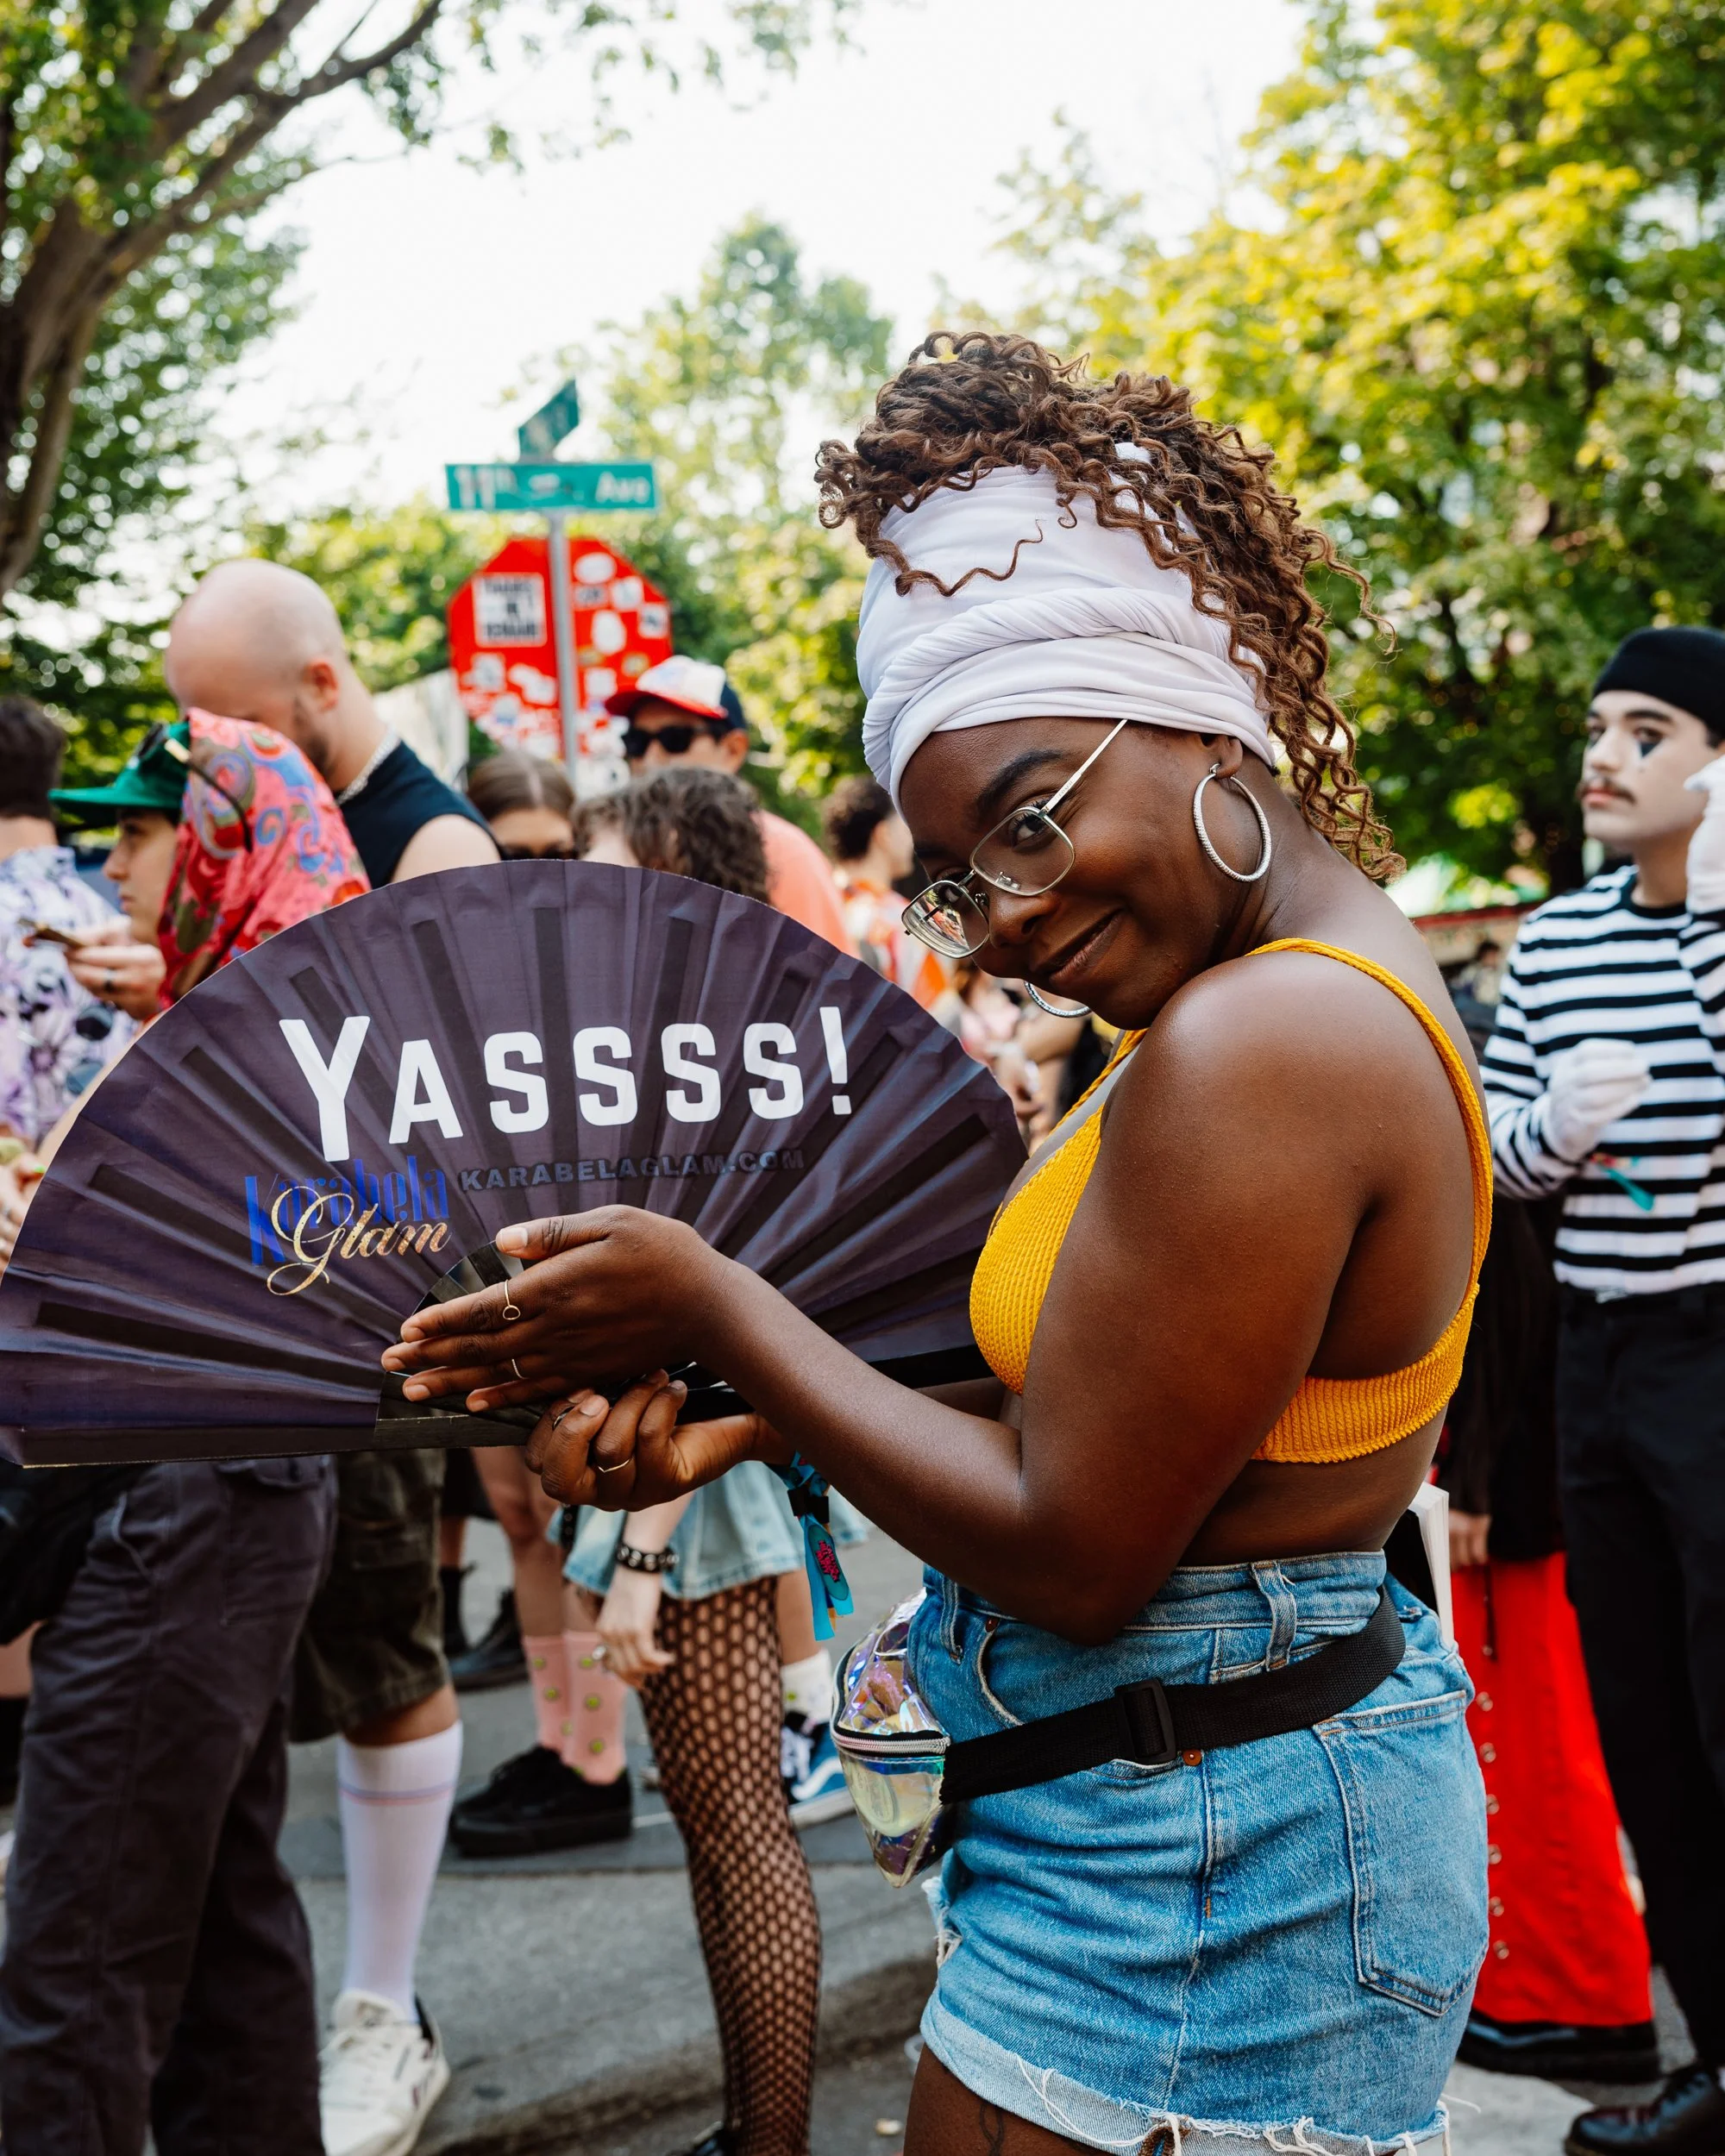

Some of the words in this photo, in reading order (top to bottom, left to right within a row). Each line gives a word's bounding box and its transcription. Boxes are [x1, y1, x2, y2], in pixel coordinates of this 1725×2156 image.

[595, 471, 651, 505] Ave
[279, 1006, 852, 1162] YASSSS!
[245, 1155, 450, 1266] Karabela
[460, 1150, 805, 1191] KARABELAGLAM.COM
[267, 1185, 453, 1296] Glam
